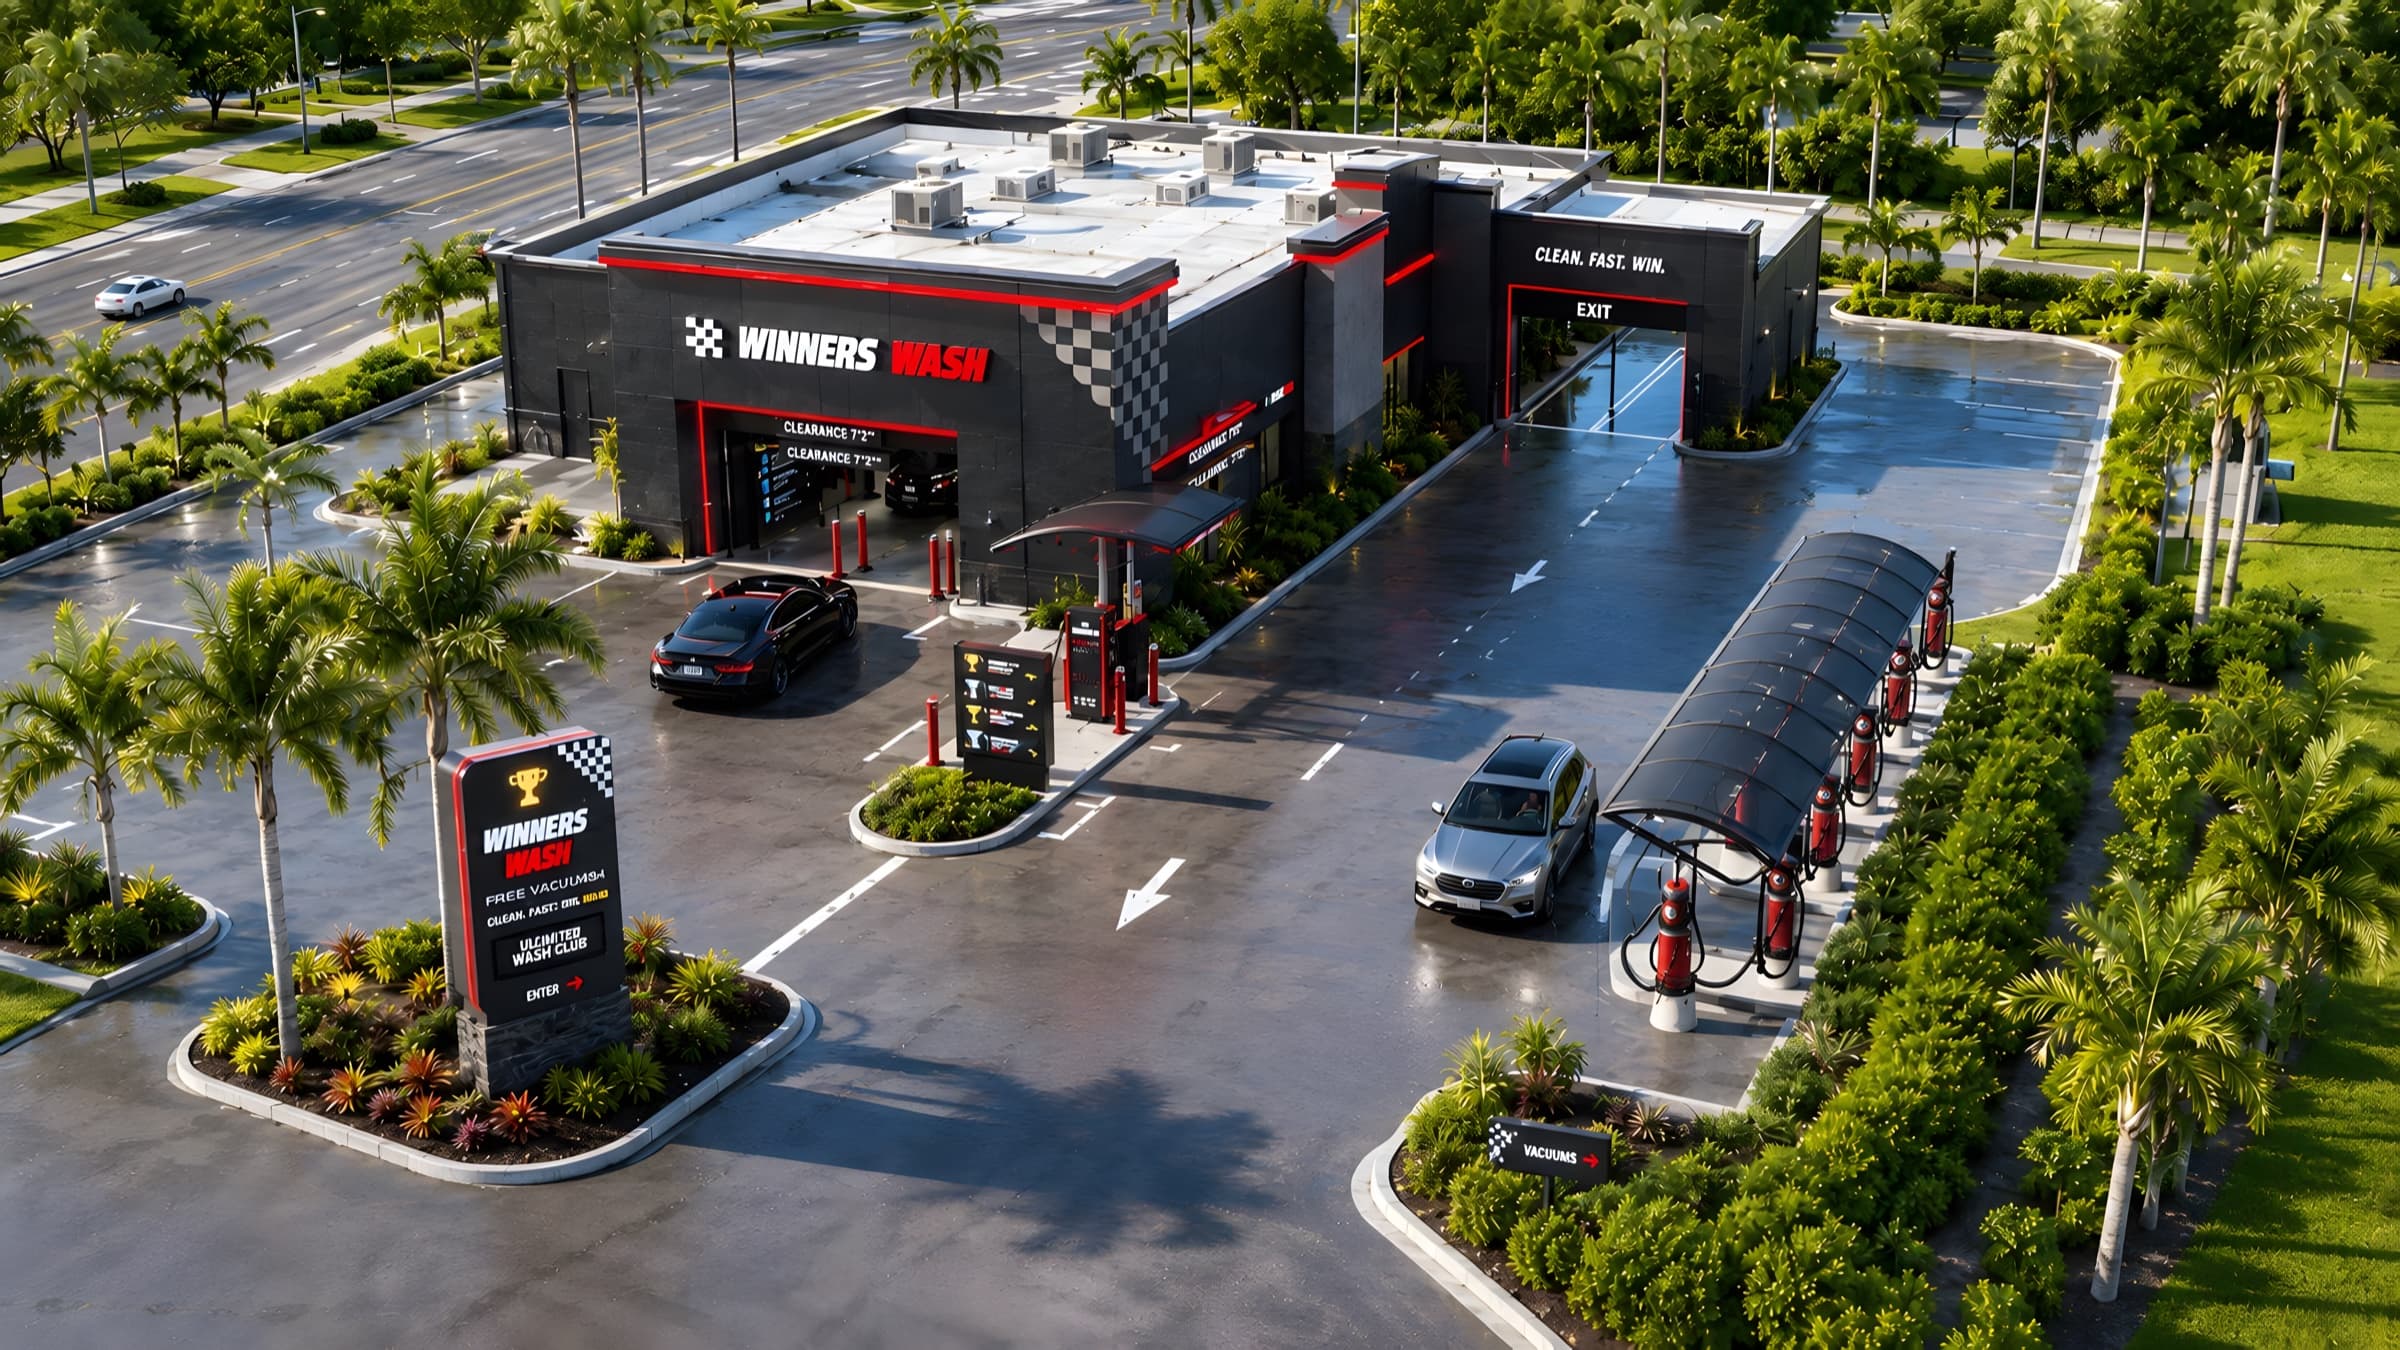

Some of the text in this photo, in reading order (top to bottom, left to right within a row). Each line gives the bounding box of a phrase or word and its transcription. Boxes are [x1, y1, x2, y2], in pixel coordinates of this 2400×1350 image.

[1535, 246, 1665, 274] CLEAN. FAST. WIN.
[1577, 302, 1612, 319] EXIT
[738, 326, 989, 382] WINNERS WASH
[483, 808, 588, 854] WINNERS
[505, 839, 573, 879] WASH
[485, 888, 526, 907] FREE
[512, 937, 588, 967] WASH CLUB
[1523, 1144, 1577, 1164] VACUUMS
